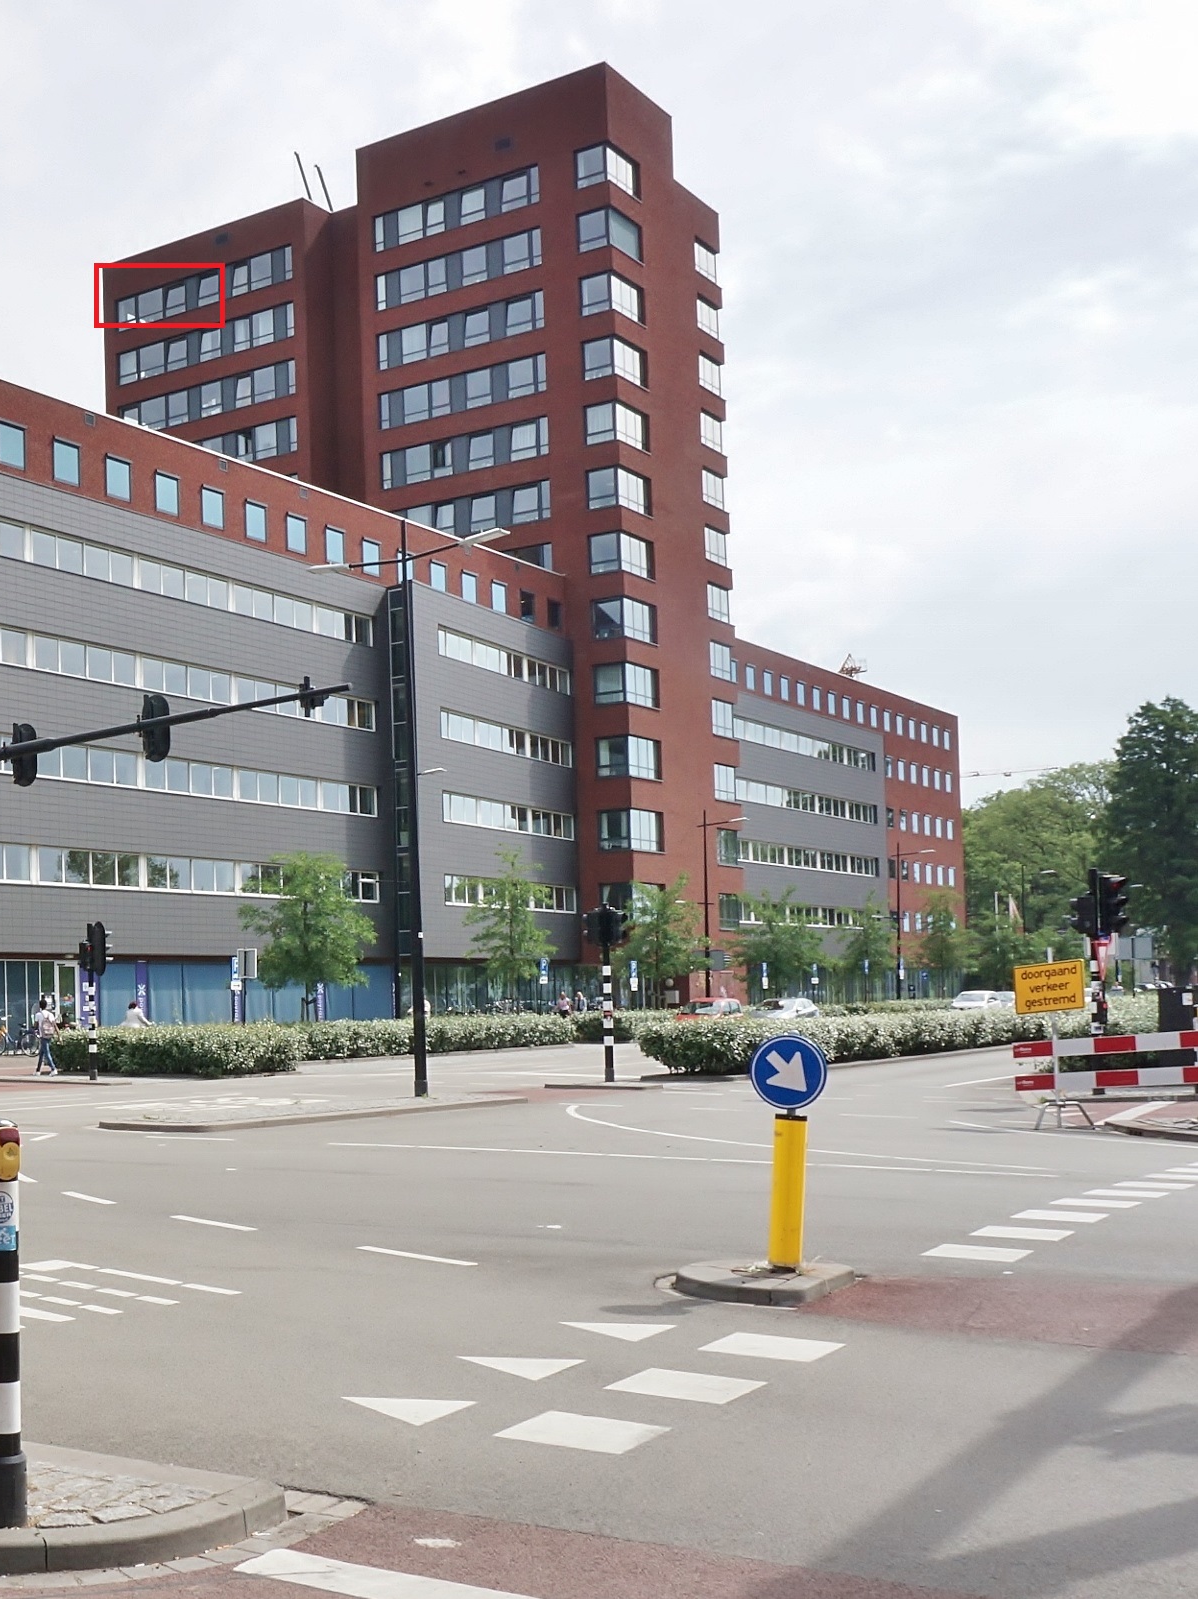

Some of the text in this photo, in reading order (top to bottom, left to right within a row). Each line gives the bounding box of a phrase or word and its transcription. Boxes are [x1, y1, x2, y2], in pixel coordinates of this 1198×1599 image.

[1021, 965, 1077, 980] doorgaand
[1029, 981, 1070, 993] verkeer
[1025, 993, 1076, 1010] gestremd
